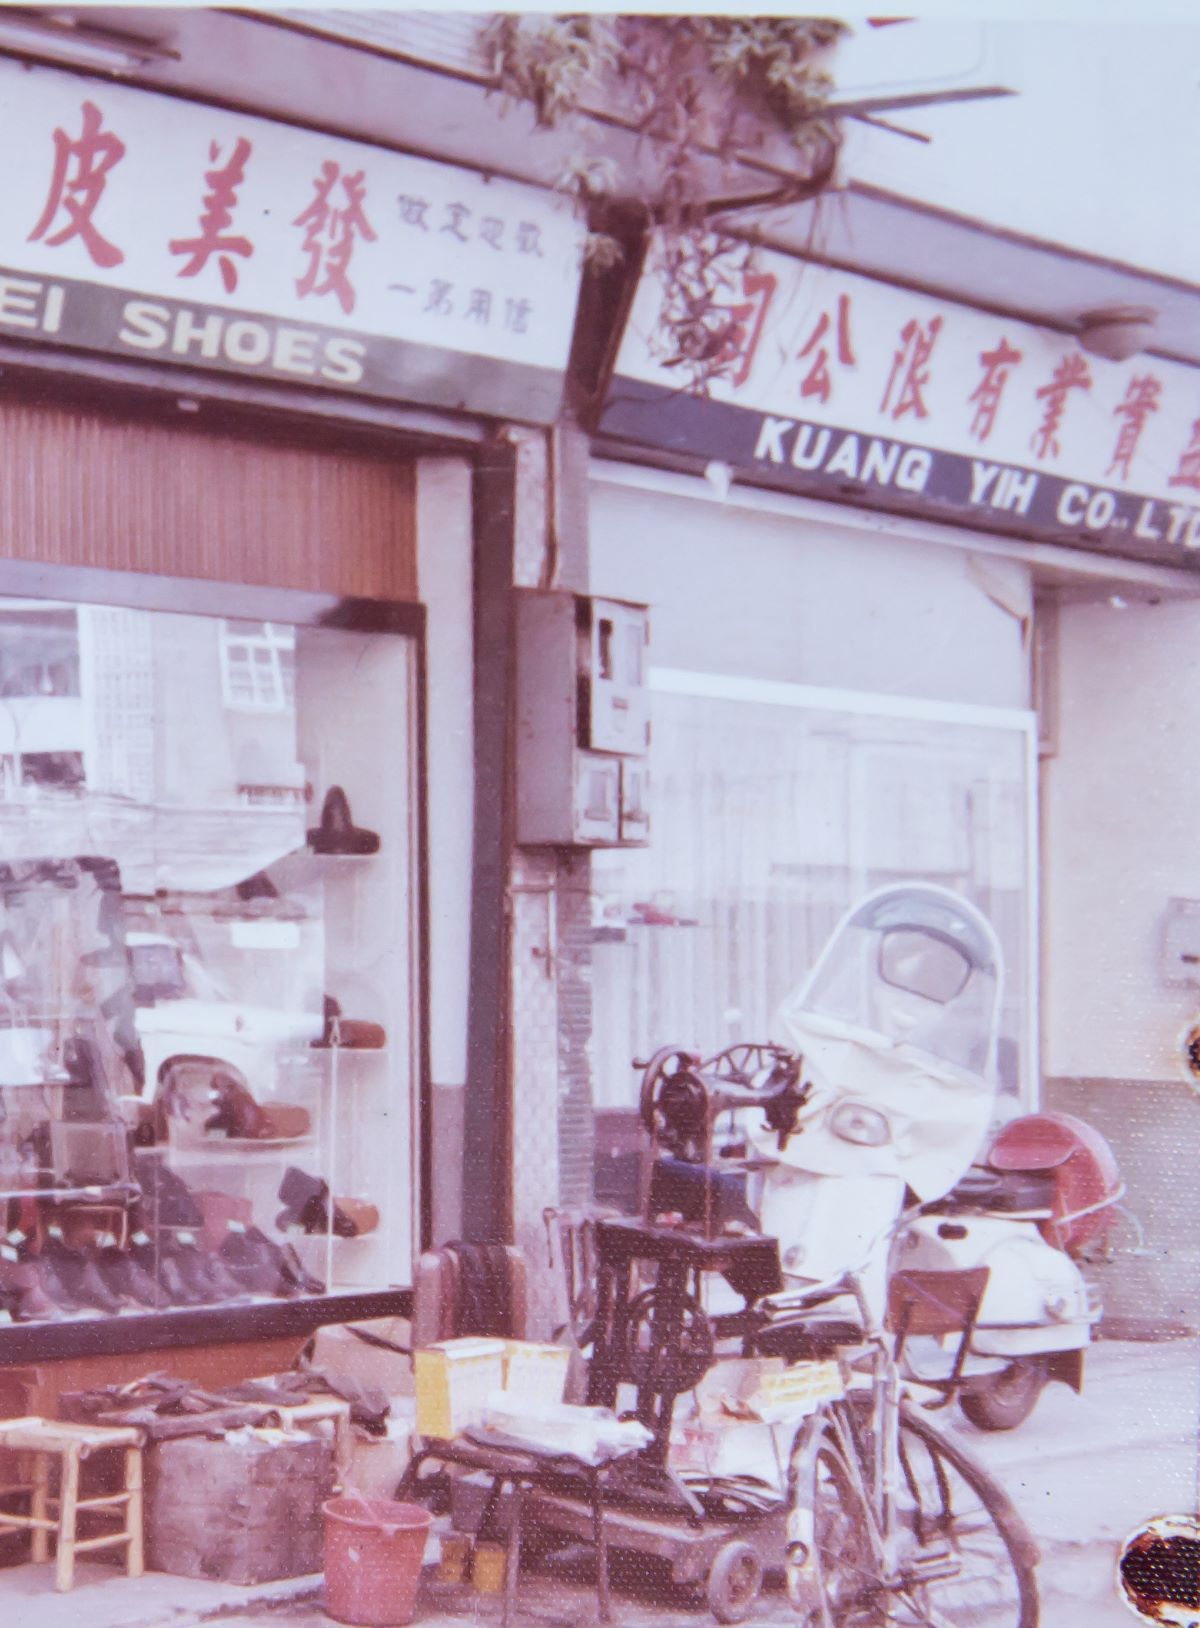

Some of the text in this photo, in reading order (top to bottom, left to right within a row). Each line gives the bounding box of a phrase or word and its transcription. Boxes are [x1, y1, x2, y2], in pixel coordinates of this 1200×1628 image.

[119, 301, 367, 384] SHOES
[754, 417, 934, 493] KUANG
[969, 462, 1039, 515] YIH
